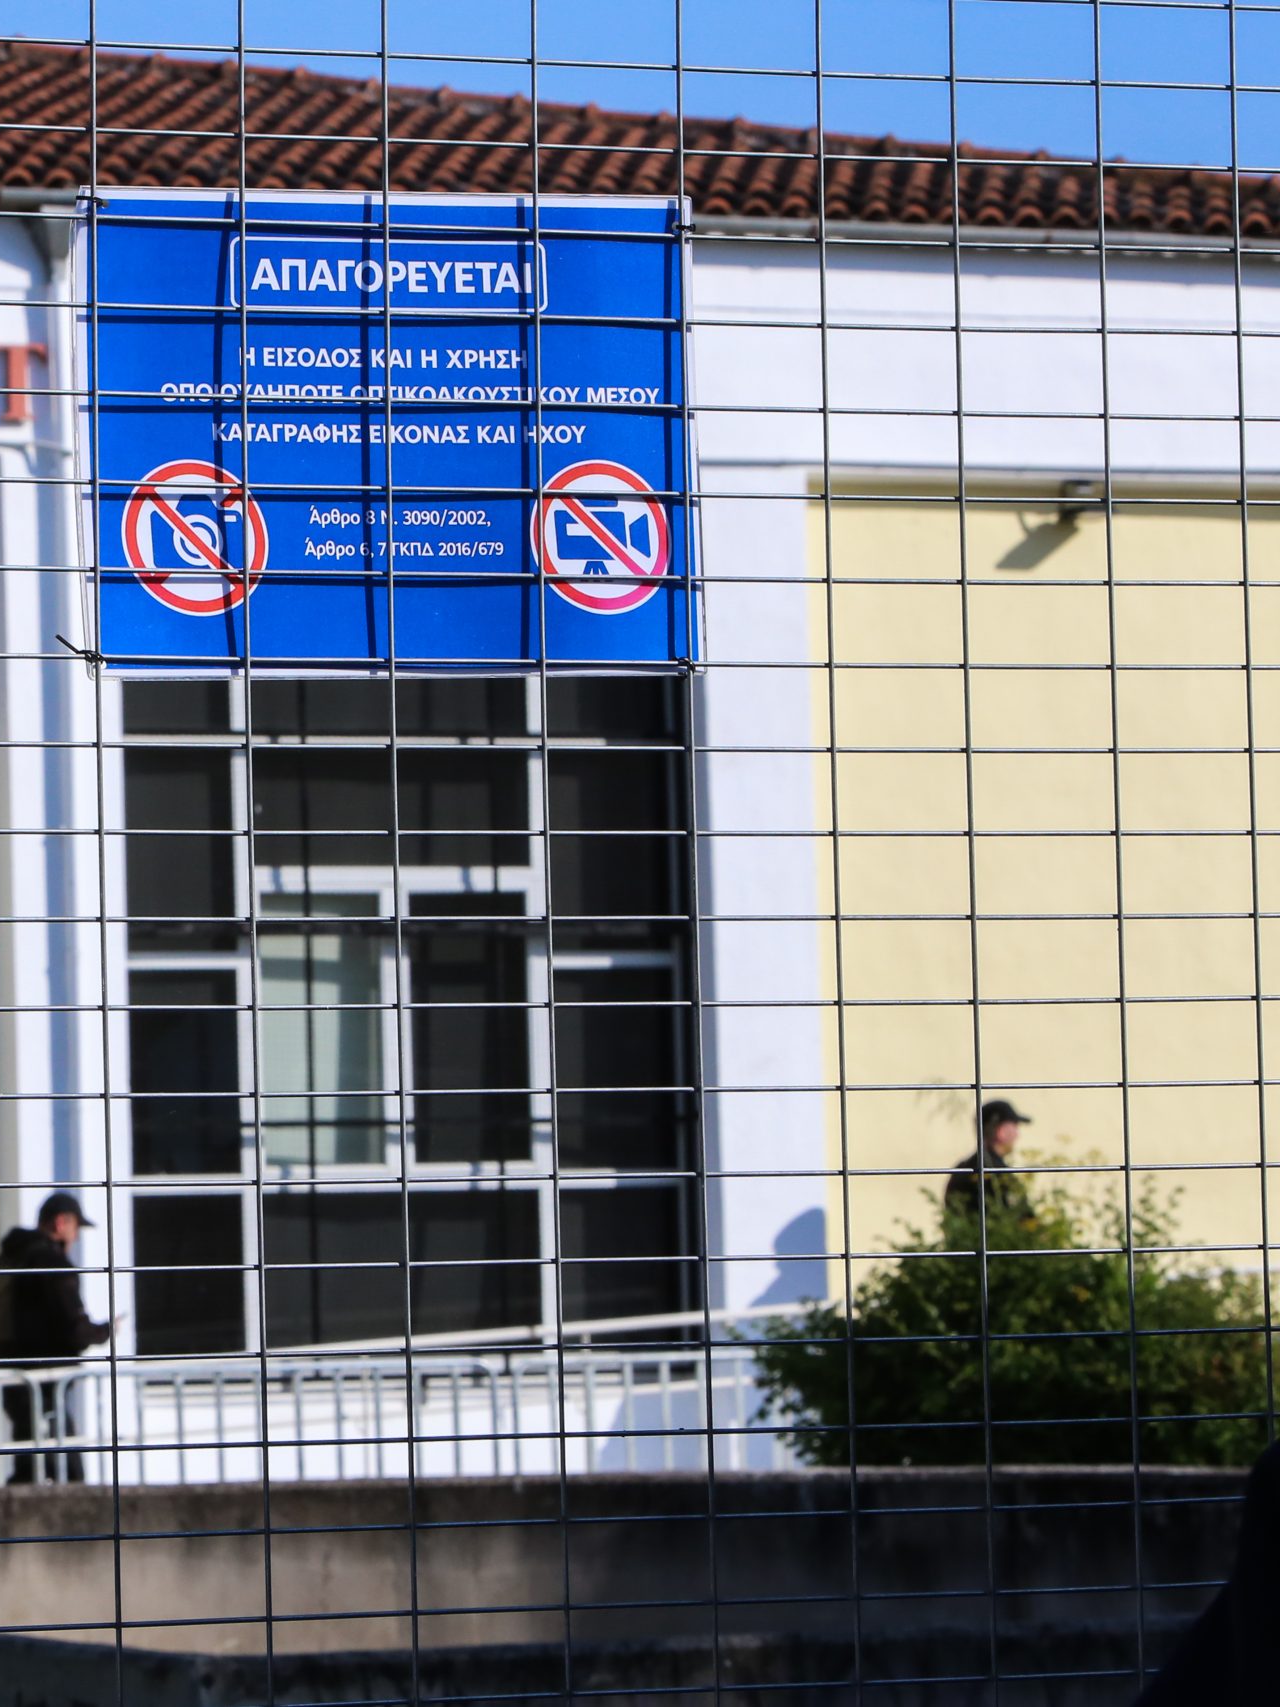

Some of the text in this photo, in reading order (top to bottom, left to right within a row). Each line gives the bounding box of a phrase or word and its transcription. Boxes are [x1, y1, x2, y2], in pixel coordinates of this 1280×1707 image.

[250, 258, 532, 295] ΑΠΑΓΟΡΕΥΕΤΑΙ
[239, 347, 528, 369] Η ΕΙΣΟΔΟΣ ΚΑΙ Η ΧΡΗΣΗ
[587, 387, 660, 405] ΜΕΣΟΥ
[212, 422, 587, 445] ΚΑΤΑΓΡΑΦΗΣ ΕΙΚΟΝΑΣ ΚΑΙ ΗΧΟΥ
[309, 505, 361, 528] Άρθρο
[366, 509, 376, 525] 8
[402, 510, 492, 528] 3090/2002,
[304, 537, 356, 560] Άρθρο
[360, 542, 375, 558] 6,
[377, 542, 387, 557] 7
[438, 542, 504, 558] 2016/679
